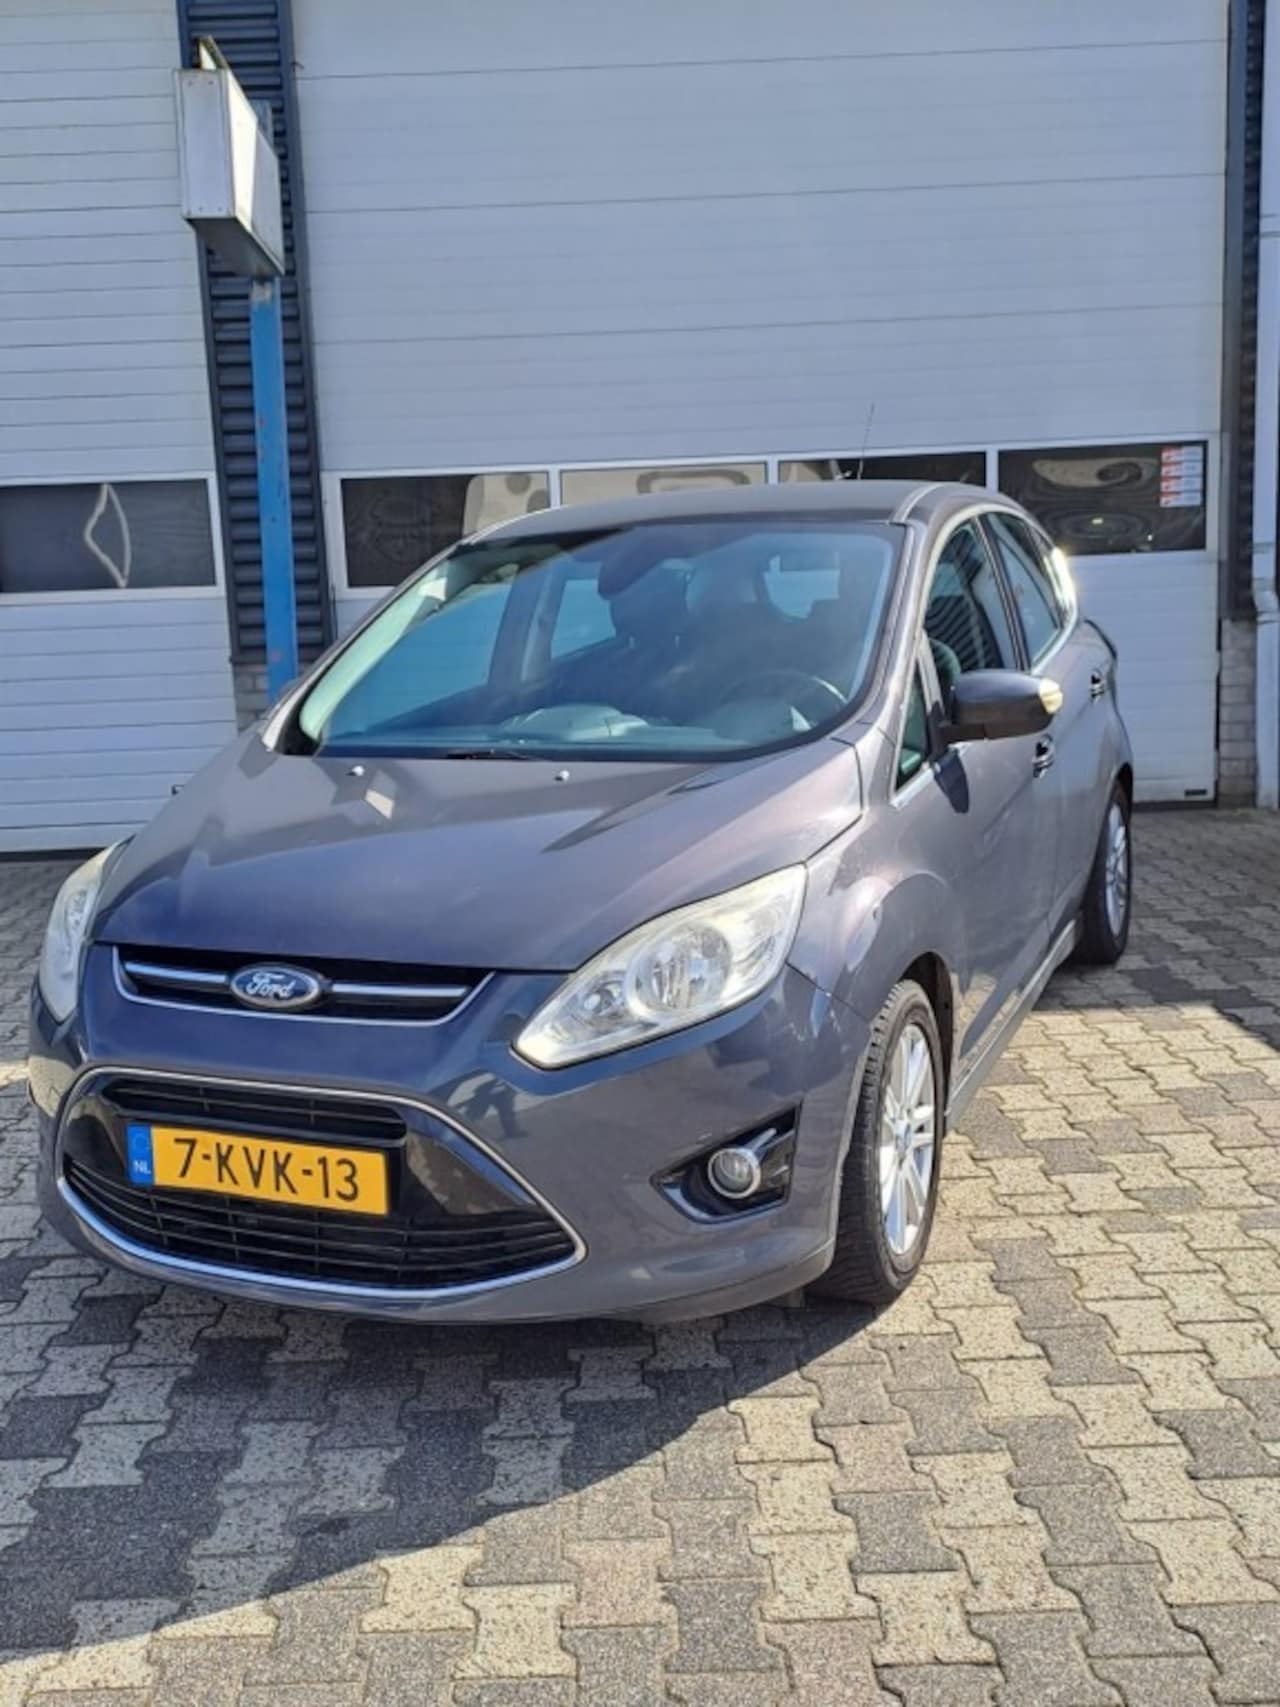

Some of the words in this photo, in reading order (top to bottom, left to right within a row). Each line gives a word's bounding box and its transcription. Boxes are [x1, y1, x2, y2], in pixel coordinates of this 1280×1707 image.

[246, 972, 296, 998] Ford
[133, 1160, 152, 1174] NL
[174, 1137, 359, 1202] 7-KVK-13
